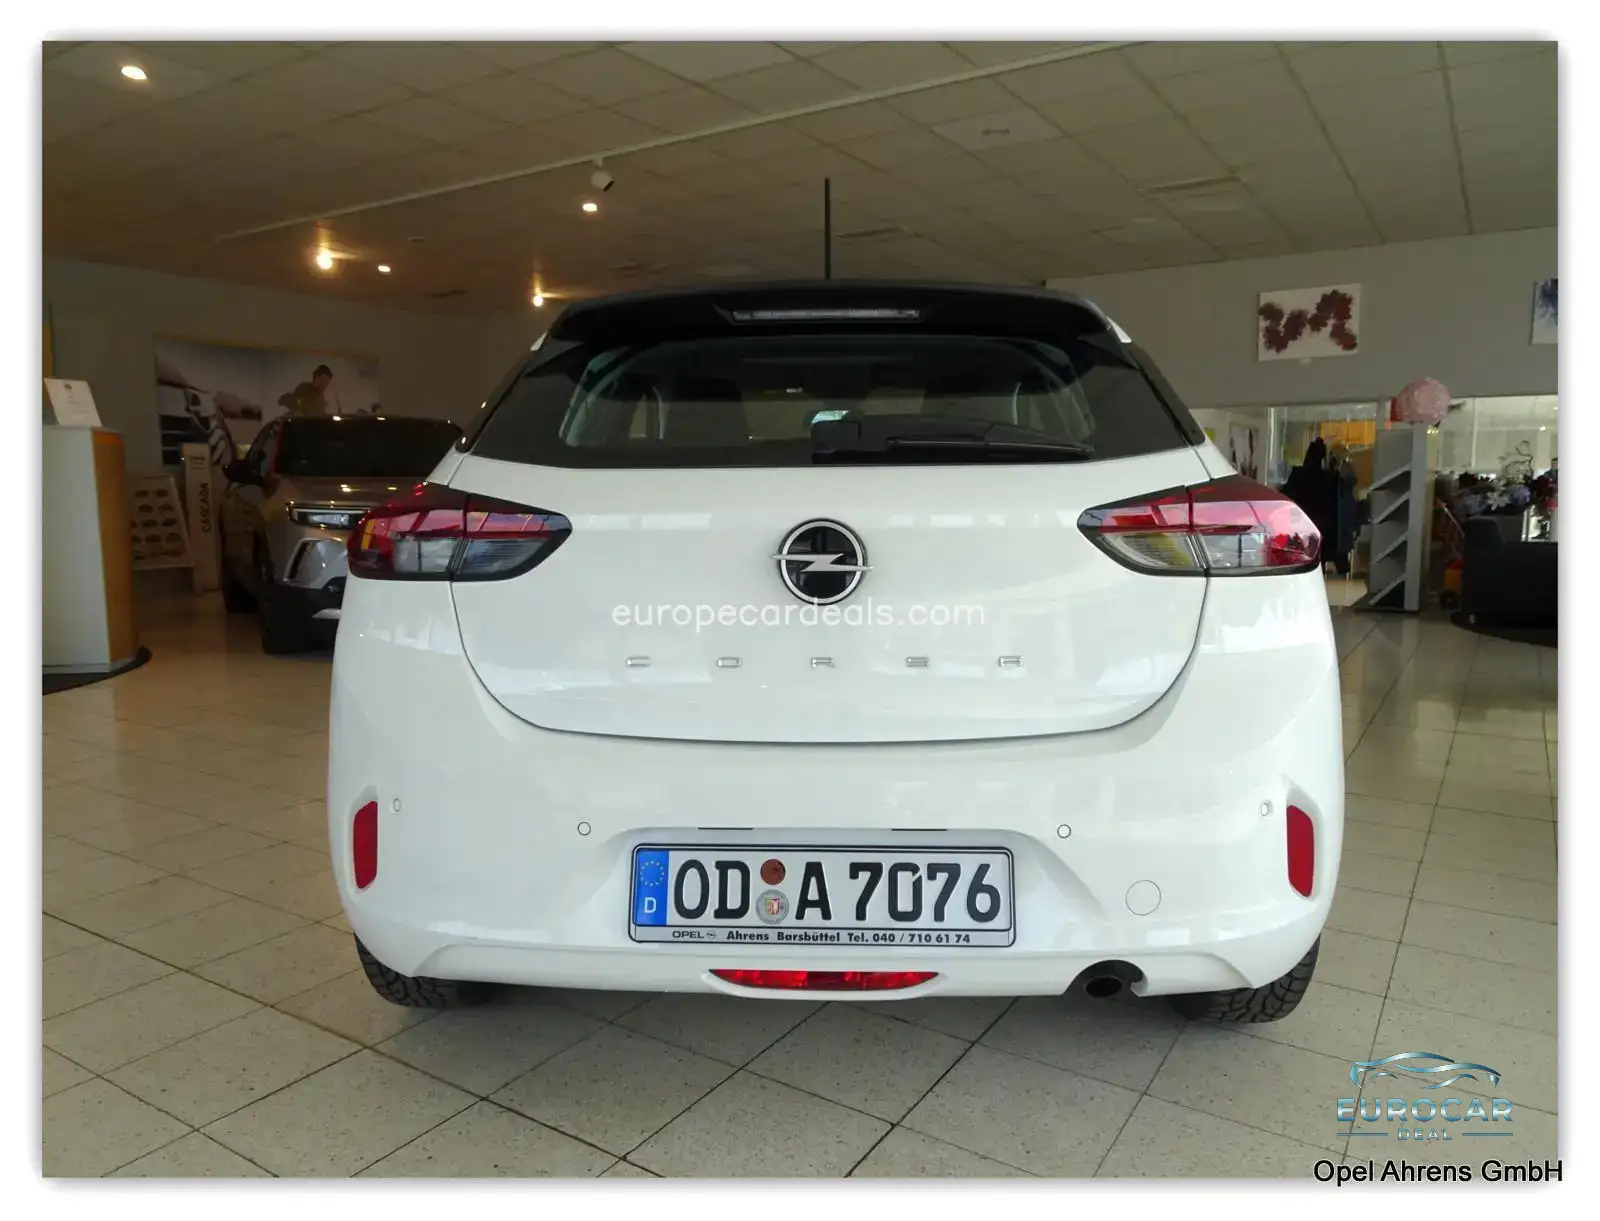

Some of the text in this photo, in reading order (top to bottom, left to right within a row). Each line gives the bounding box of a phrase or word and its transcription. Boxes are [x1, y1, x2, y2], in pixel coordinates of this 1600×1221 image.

[673, 858, 1002, 923] OD A 7076
[643, 897, 657, 914] D
[672, 930, 704, 939] OPEL
[726, 930, 769, 941] Ahrens
[777, 931, 840, 942] Barsbüttel
[847, 932, 869, 943] Tel.
[872, 933, 896, 943] 040
[908, 933, 932, 943] 710
[935, 934, 950, 943] 61
[955, 934, 971, 944] 74
